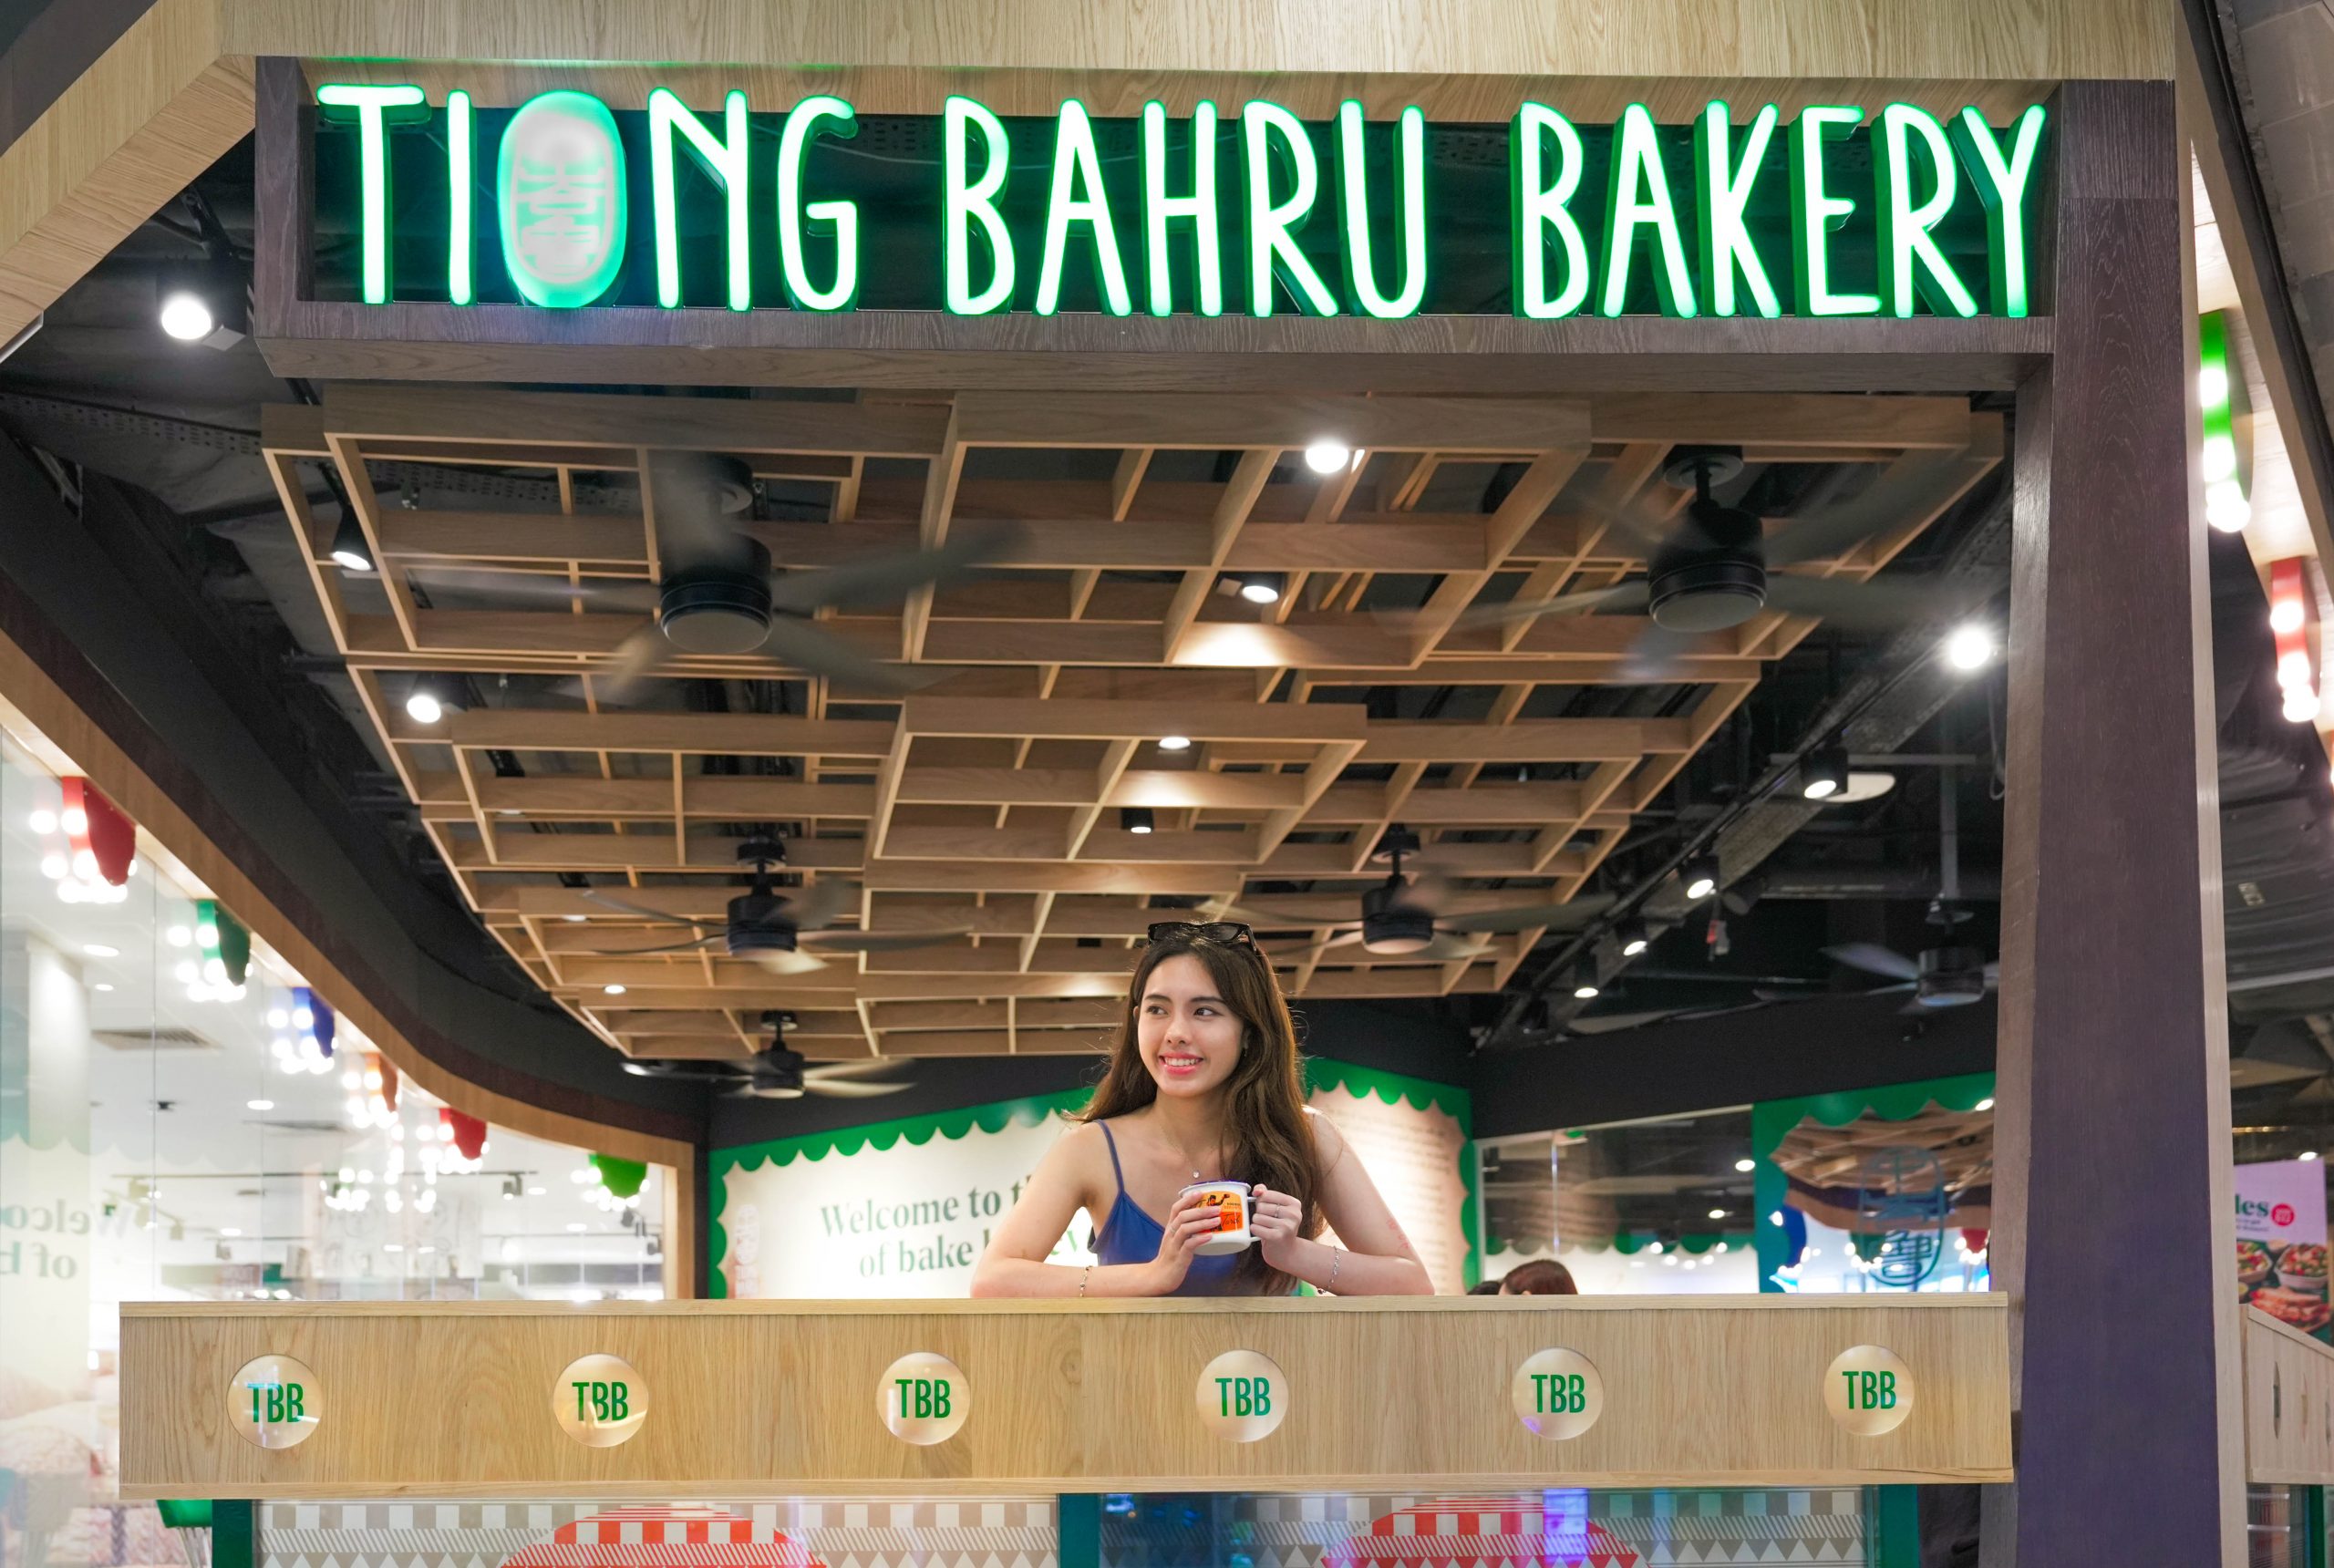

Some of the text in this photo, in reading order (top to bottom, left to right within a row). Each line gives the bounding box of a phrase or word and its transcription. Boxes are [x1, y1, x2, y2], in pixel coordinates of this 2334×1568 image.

[316, 85, 859, 311] TIONG
[942, 94, 1427, 318] BAHRU
[1512, 99, 2048, 318] BAKERY
[821, 1195, 959, 1237] Welcome
[967, 1187, 1001, 1218] to
[2236, 1193, 2269, 1217] les
[860, 1243, 890, 1277] of
[899, 1234, 973, 1273] bake
[247, 1382, 305, 1423] TBB
[572, 1381, 629, 1421] TBB
[895, 1378, 951, 1418] TBB
[1214, 1377, 1271, 1417] TBB
[1531, 1374, 1585, 1414] TBB
[1842, 1370, 1896, 1410] TBB
